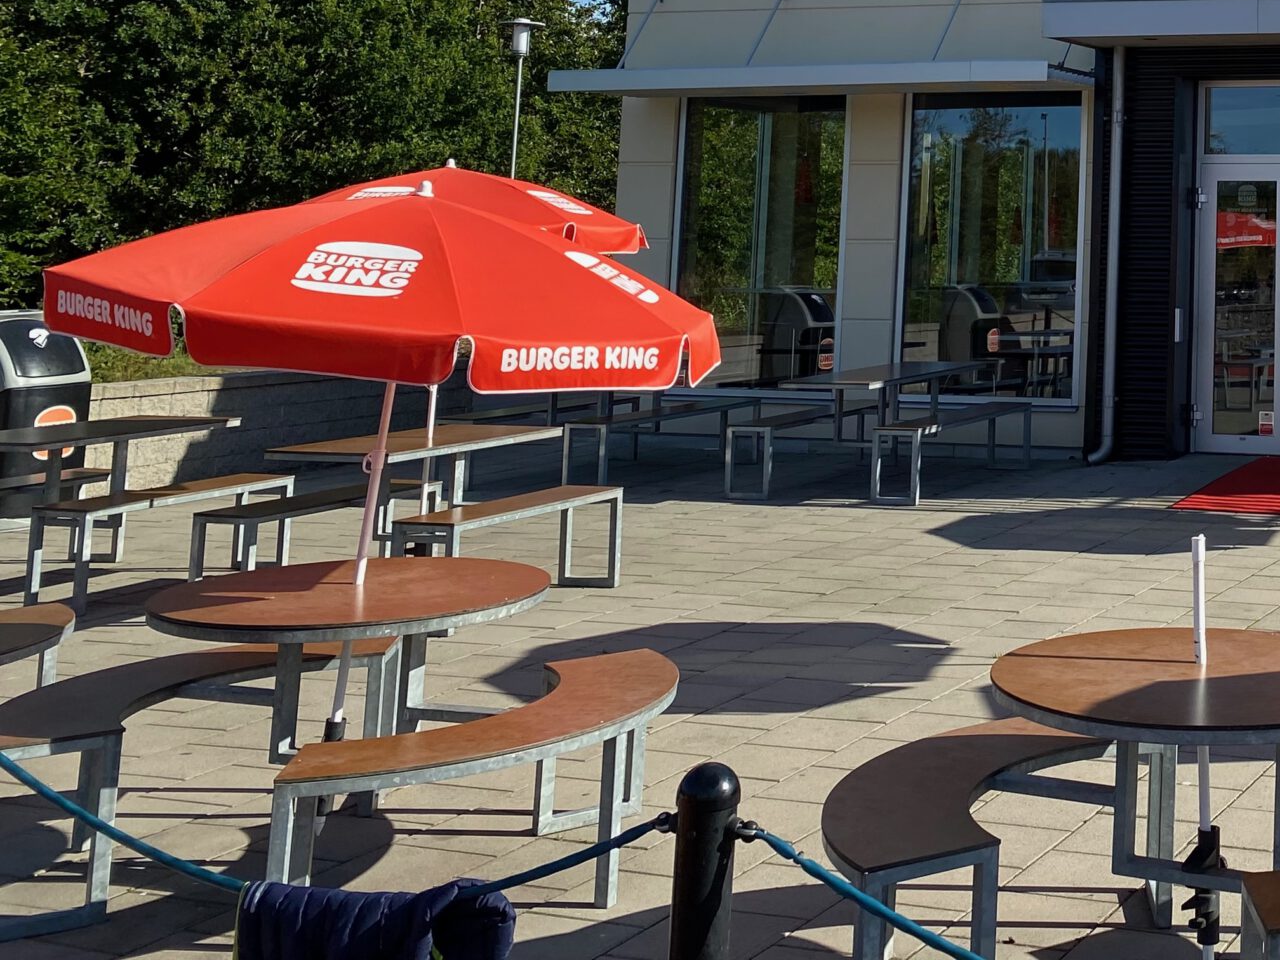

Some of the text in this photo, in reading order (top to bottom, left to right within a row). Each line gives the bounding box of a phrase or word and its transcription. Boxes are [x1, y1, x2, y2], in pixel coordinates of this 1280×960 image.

[295, 262, 411, 288] KING
[306, 251, 419, 272] BURGER
[57, 290, 153, 337] BURGER KING
[501, 345, 659, 373] BURGER KING
